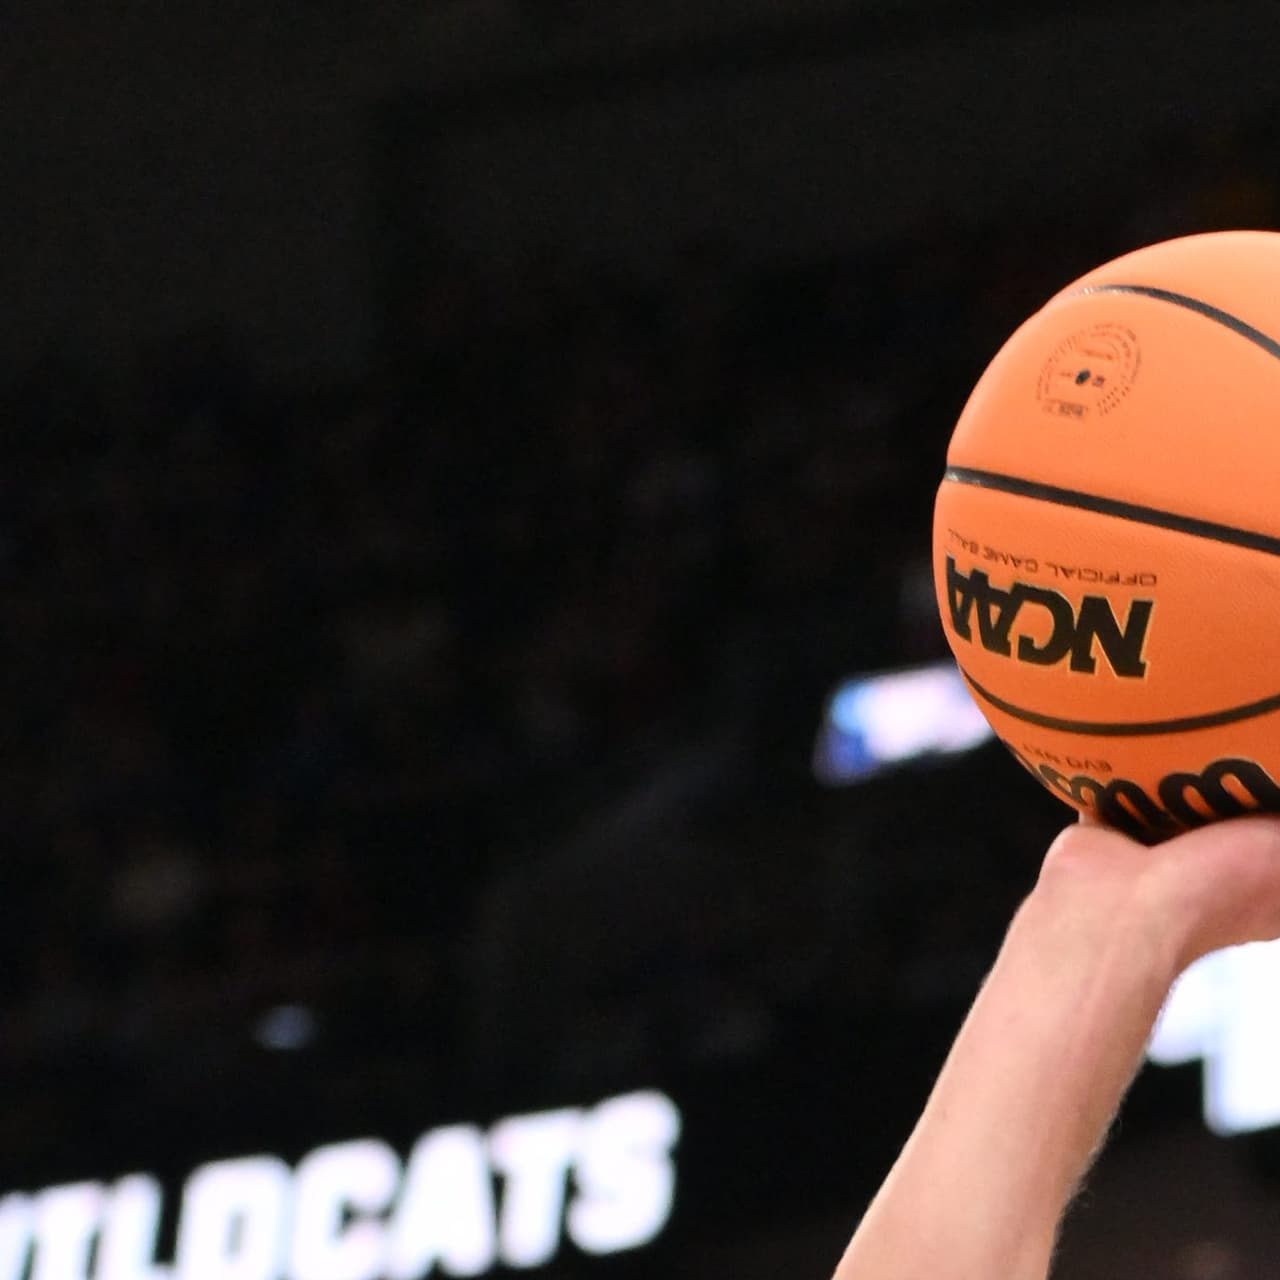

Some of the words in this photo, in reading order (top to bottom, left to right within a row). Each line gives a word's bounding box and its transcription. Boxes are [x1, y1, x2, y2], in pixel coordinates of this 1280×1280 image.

[983, 546, 1039, 574] GAME
[1046, 562, 1157, 586] OFFICIAL
[946, 554, 1155, 679] NCAA
